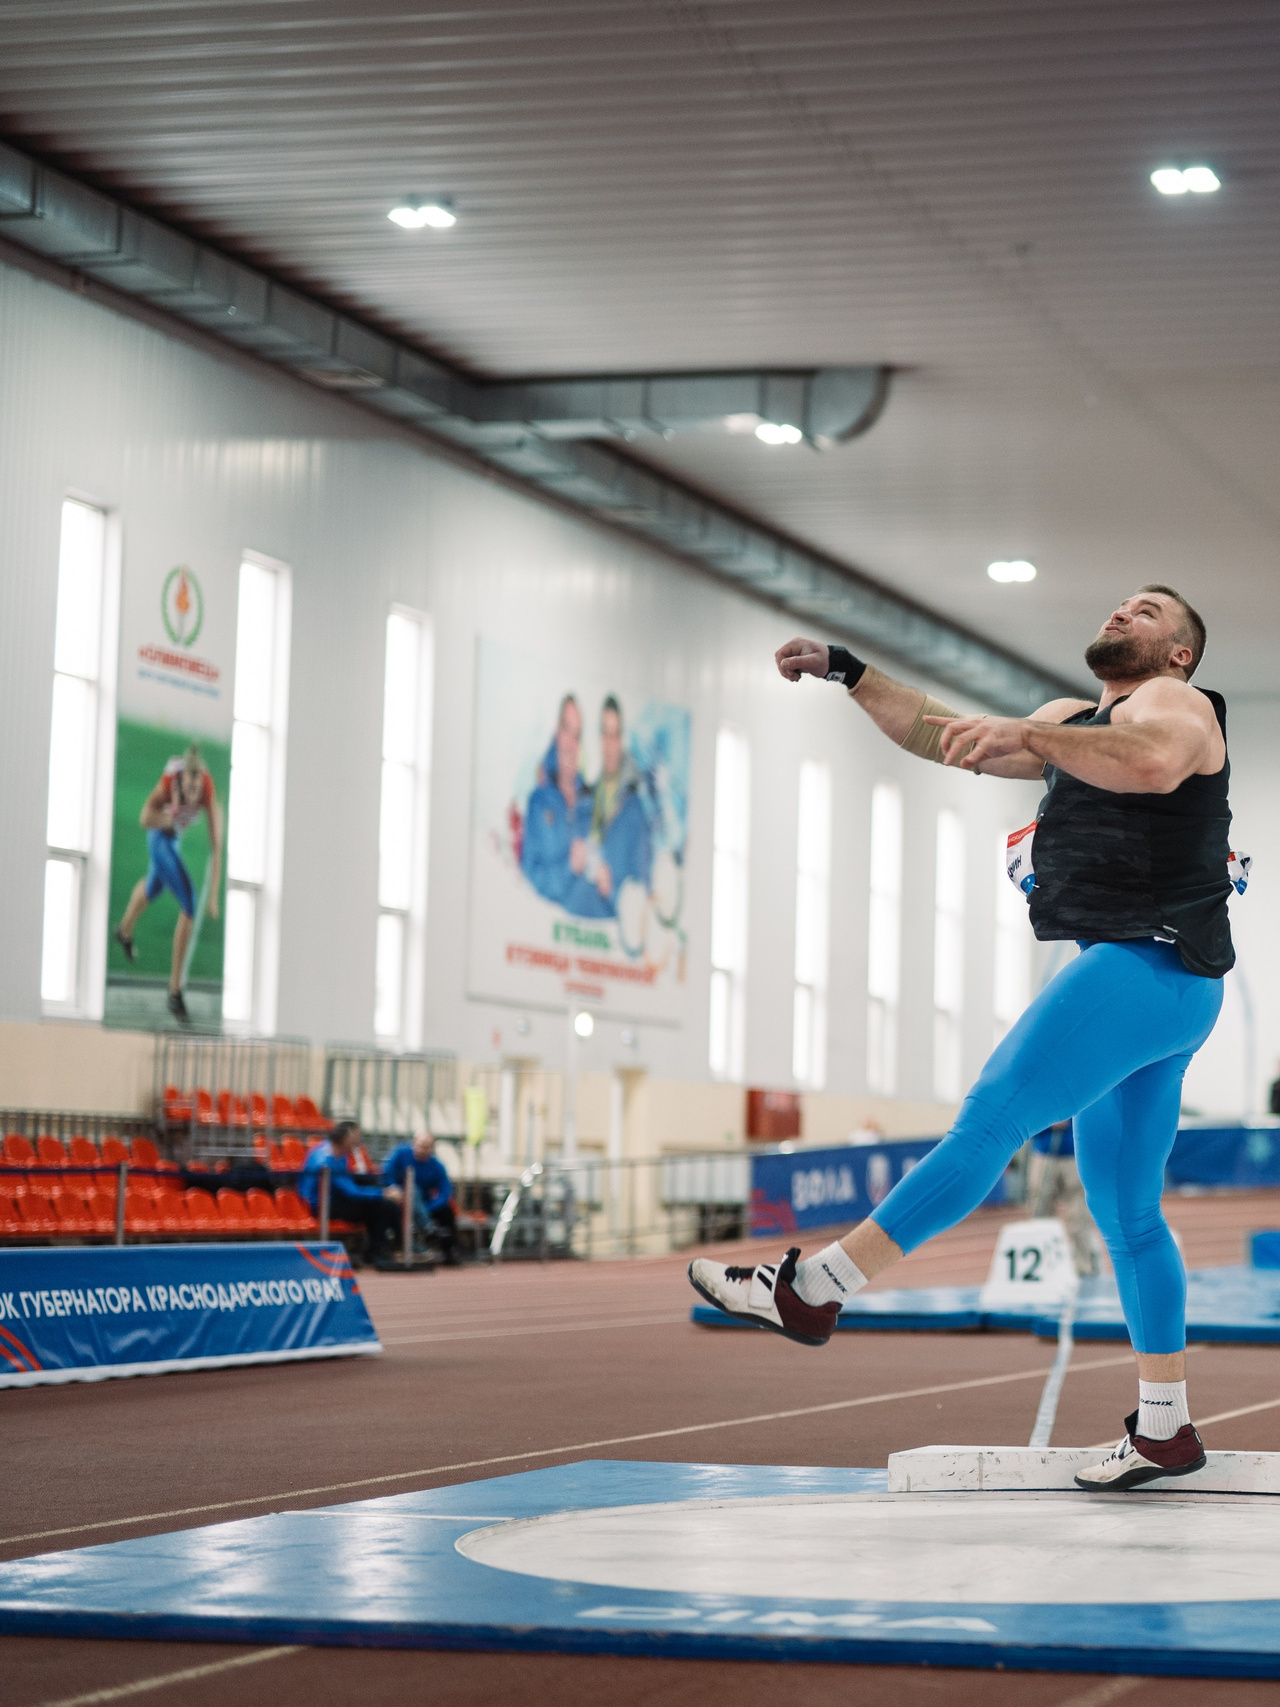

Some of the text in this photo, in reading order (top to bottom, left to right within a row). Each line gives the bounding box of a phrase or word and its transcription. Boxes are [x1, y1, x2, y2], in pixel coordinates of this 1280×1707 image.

[1004, 1247, 1043, 1282] 12
[19, 1286, 144, 1319] ГУБЕРНАТОРА
[146, 1279, 304, 1312] КРАСНОДАРСКОГО
[574, 1605, 999, 1633] DIMA
